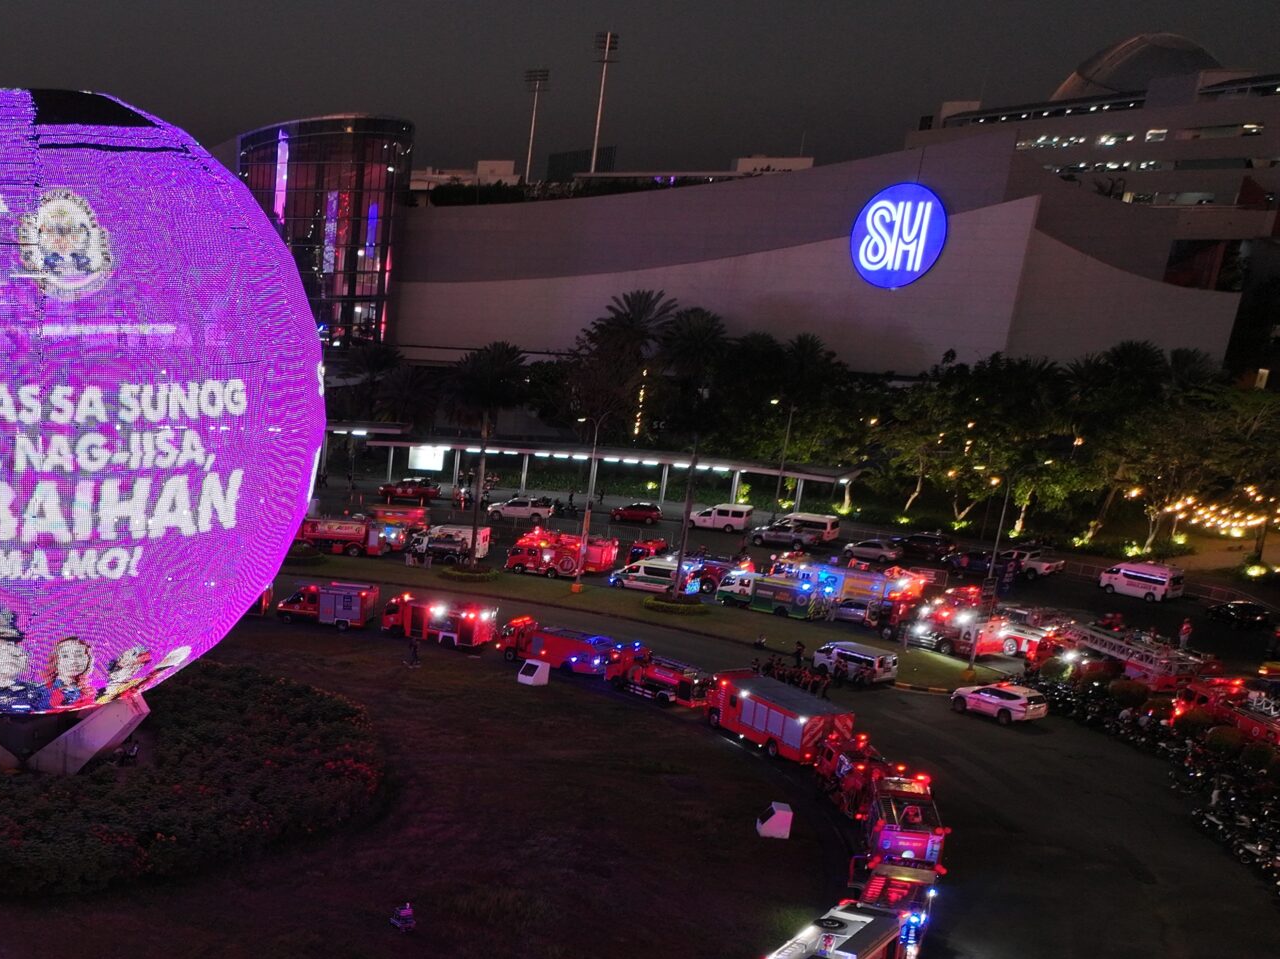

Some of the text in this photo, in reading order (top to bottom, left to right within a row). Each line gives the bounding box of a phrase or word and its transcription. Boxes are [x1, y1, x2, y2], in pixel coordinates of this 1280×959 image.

[859, 200, 932, 272] SM
[49, 386, 104, 425] SA
[118, 378, 248, 425] SUNOG
[64, 545, 143, 580] MO!
